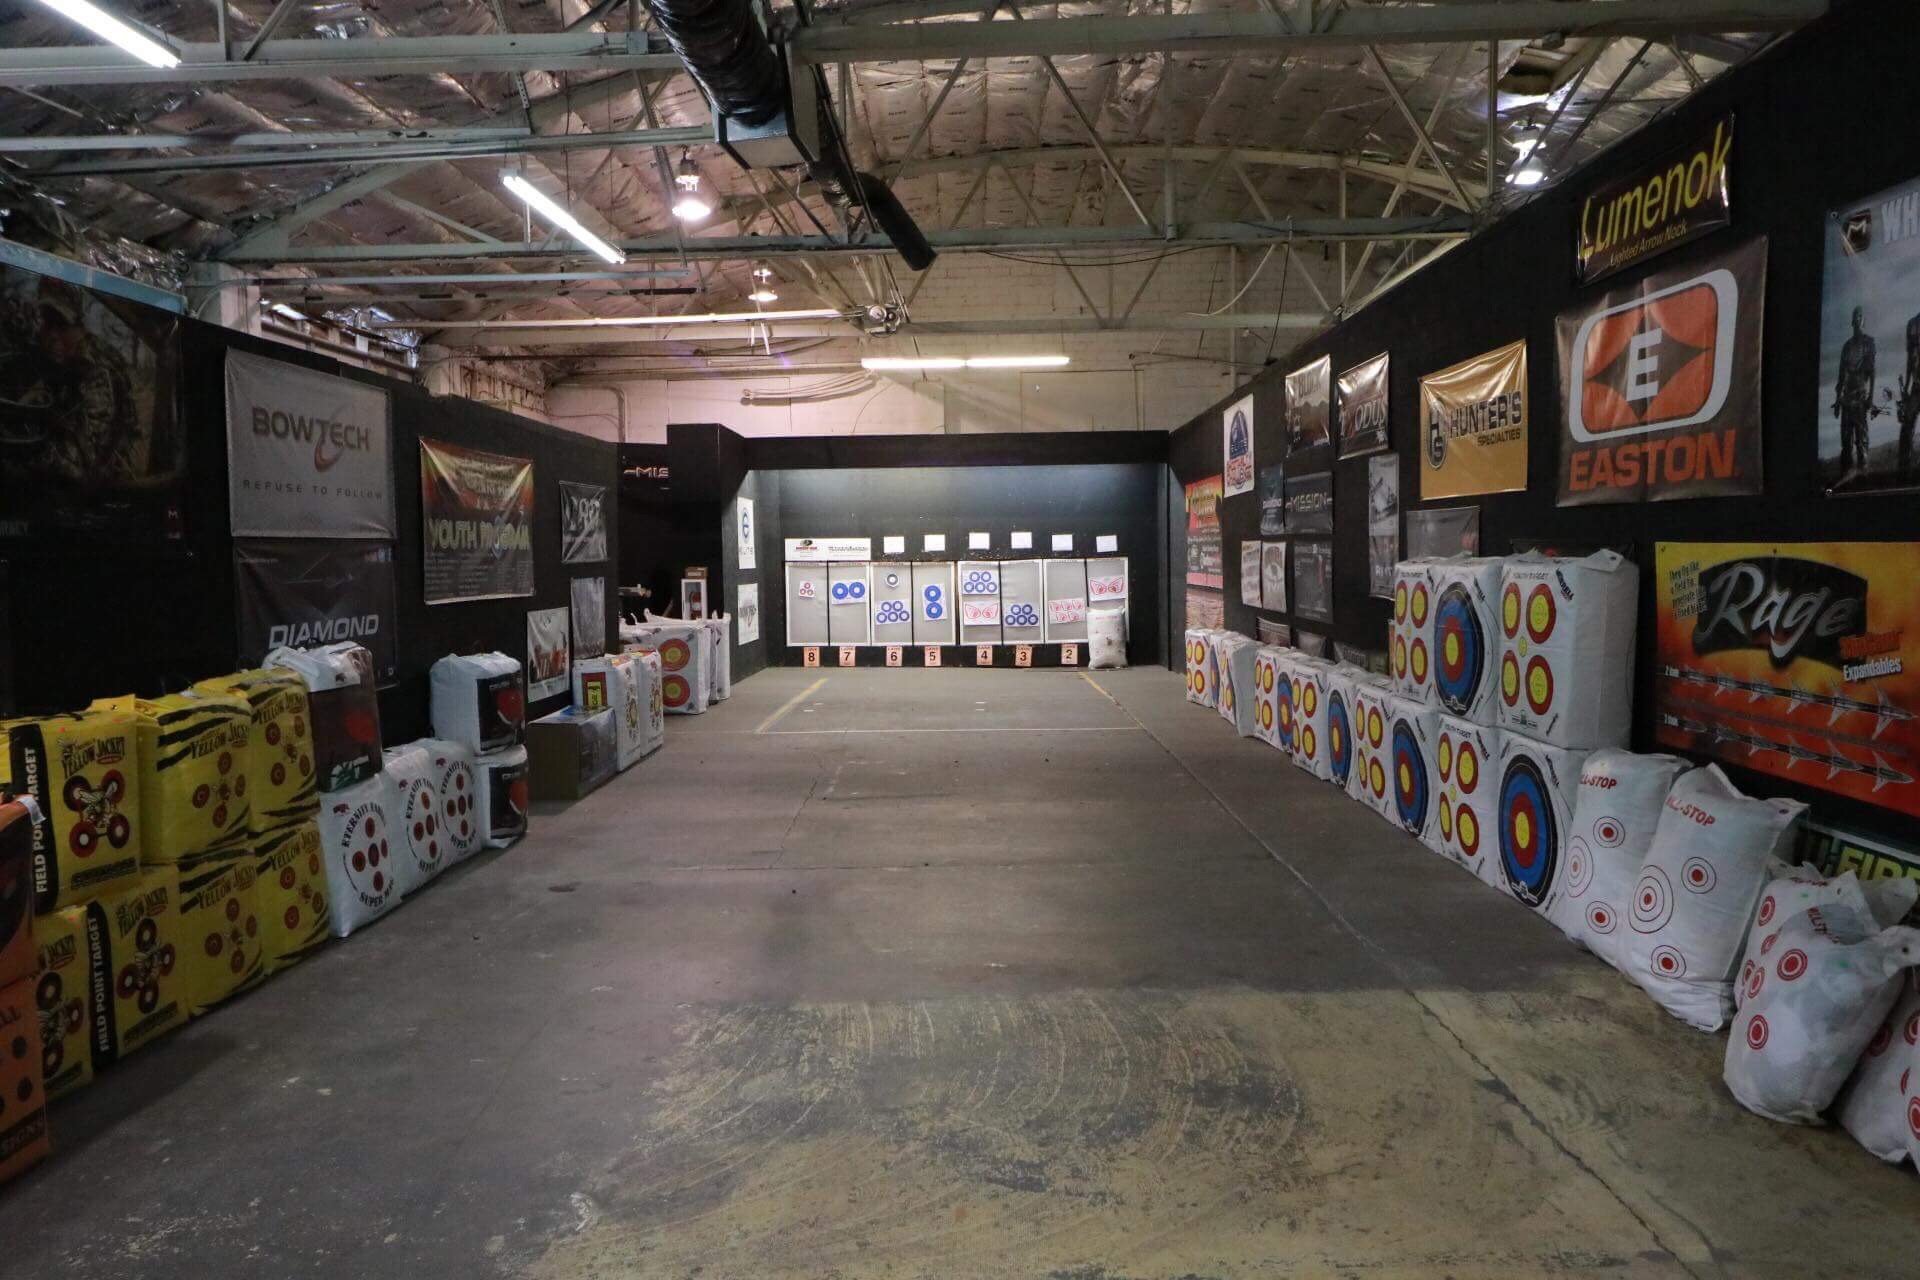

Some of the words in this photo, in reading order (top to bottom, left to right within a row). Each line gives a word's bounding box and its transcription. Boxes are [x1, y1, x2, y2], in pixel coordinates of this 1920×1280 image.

[1579, 121, 1731, 260] Lumenok
[1638, 232, 1665, 253] Arrow
[1450, 390, 1523, 439] HUNTER'S
[252, 405, 371, 472] BOWTECH
[1477, 427, 1521, 447] SPECIALTIES
[1568, 430, 1737, 492] EASTON
[243, 479, 303, 494] REFUSE
[313, 485, 328, 495] TO
[336, 487, 383, 500] FOLLOW
[429, 518, 478, 552] YOUTH
[1700, 561, 1857, 660] Rage
[268, 614, 379, 650] DIAMOND
[808, 652, 816, 662] 8
[844, 652, 851, 661] 7
[891, 652, 898, 662] 6
[930, 652, 937, 661] 5
[981, 650, 988, 660] 4
[1020, 652, 1027, 661] 3
[1066, 649, 1073, 659] 2
[1843, 656, 1902, 682] Expandables
[256, 702, 284, 725] YELLOW
[189, 734, 225, 760] YELLOW
[62, 747, 96, 780] YELLOW
[341, 803, 370, 849] ETERNITY
[270, 848, 300, 871] YELLOW
[33, 853, 48, 894] FIELD
[199, 882, 232, 910] YELLOW
[88, 917, 103, 967] TARGET
[94, 970, 106, 1013] POINT
[97, 1015, 111, 1052] FIELD
